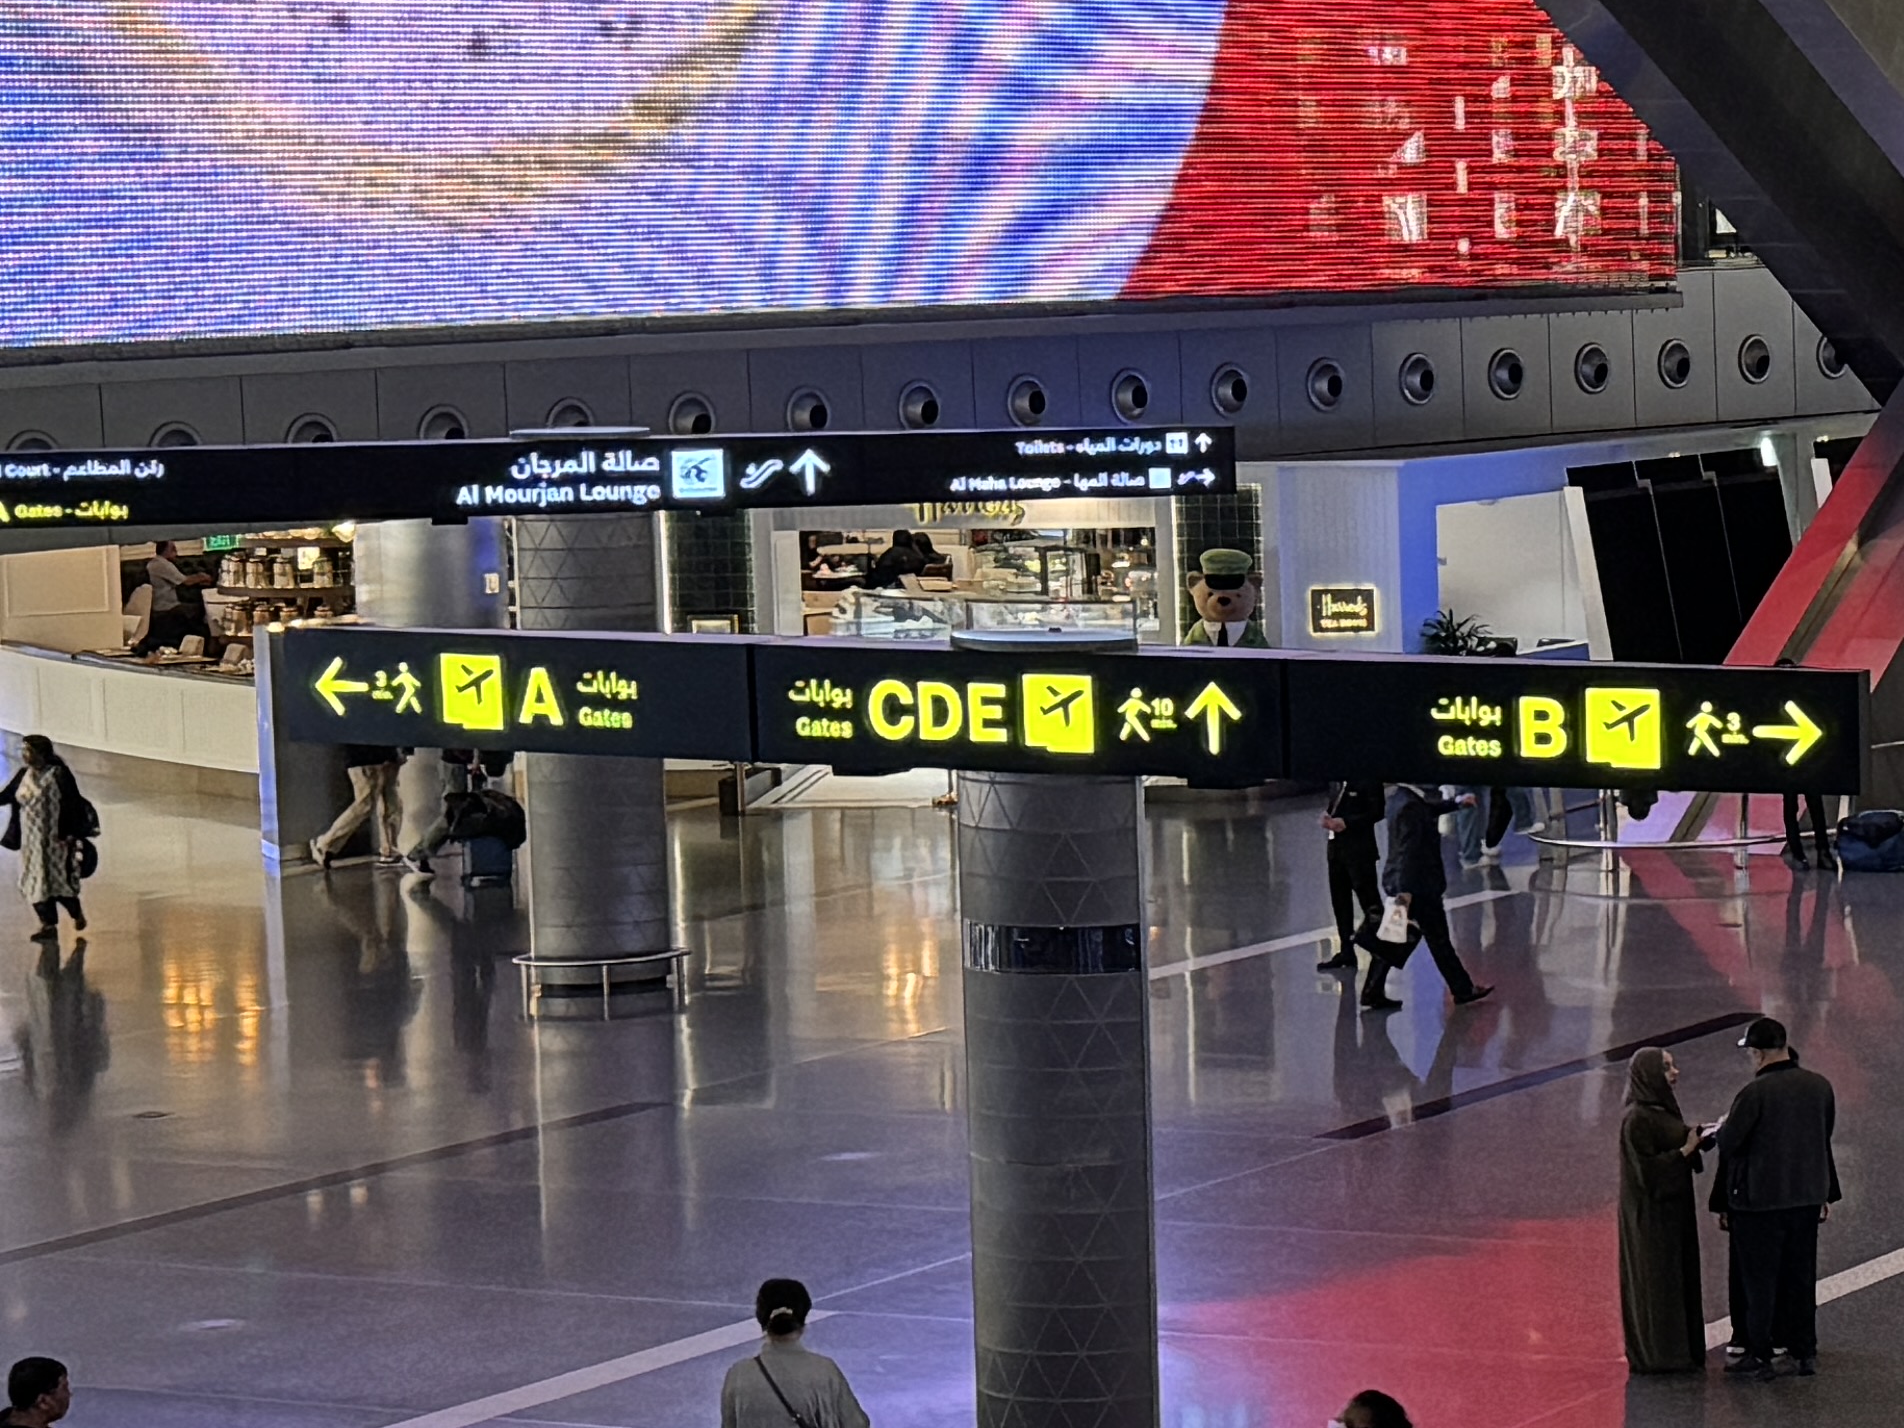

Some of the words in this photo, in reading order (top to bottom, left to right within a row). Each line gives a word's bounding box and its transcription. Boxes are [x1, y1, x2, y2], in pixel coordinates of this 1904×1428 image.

[1015, 439, 1064, 455] Toilets
[4, 463, 52, 478] Court
[510, 448, 597, 480] المرجان
[602, 450, 661, 473] صالة
[456, 485, 479, 506] Al
[485, 481, 575, 508] Mourjan
[579, 483, 662, 505] Lounge
[518, 666, 565, 727] A
[576, 670, 639, 700] بوابات
[788, 678, 854, 710] بوابات
[577, 705, 634, 729] Gates
[867, 678, 1009, 743] CDE
[1151, 697, 1174, 718] 10
[1430, 695, 1502, 727] بوابات
[795, 716, 854, 739] Gates
[1518, 695, 1568, 759] B
[1726, 712, 1741, 732] 3
[1437, 735, 1502, 758] Gates
